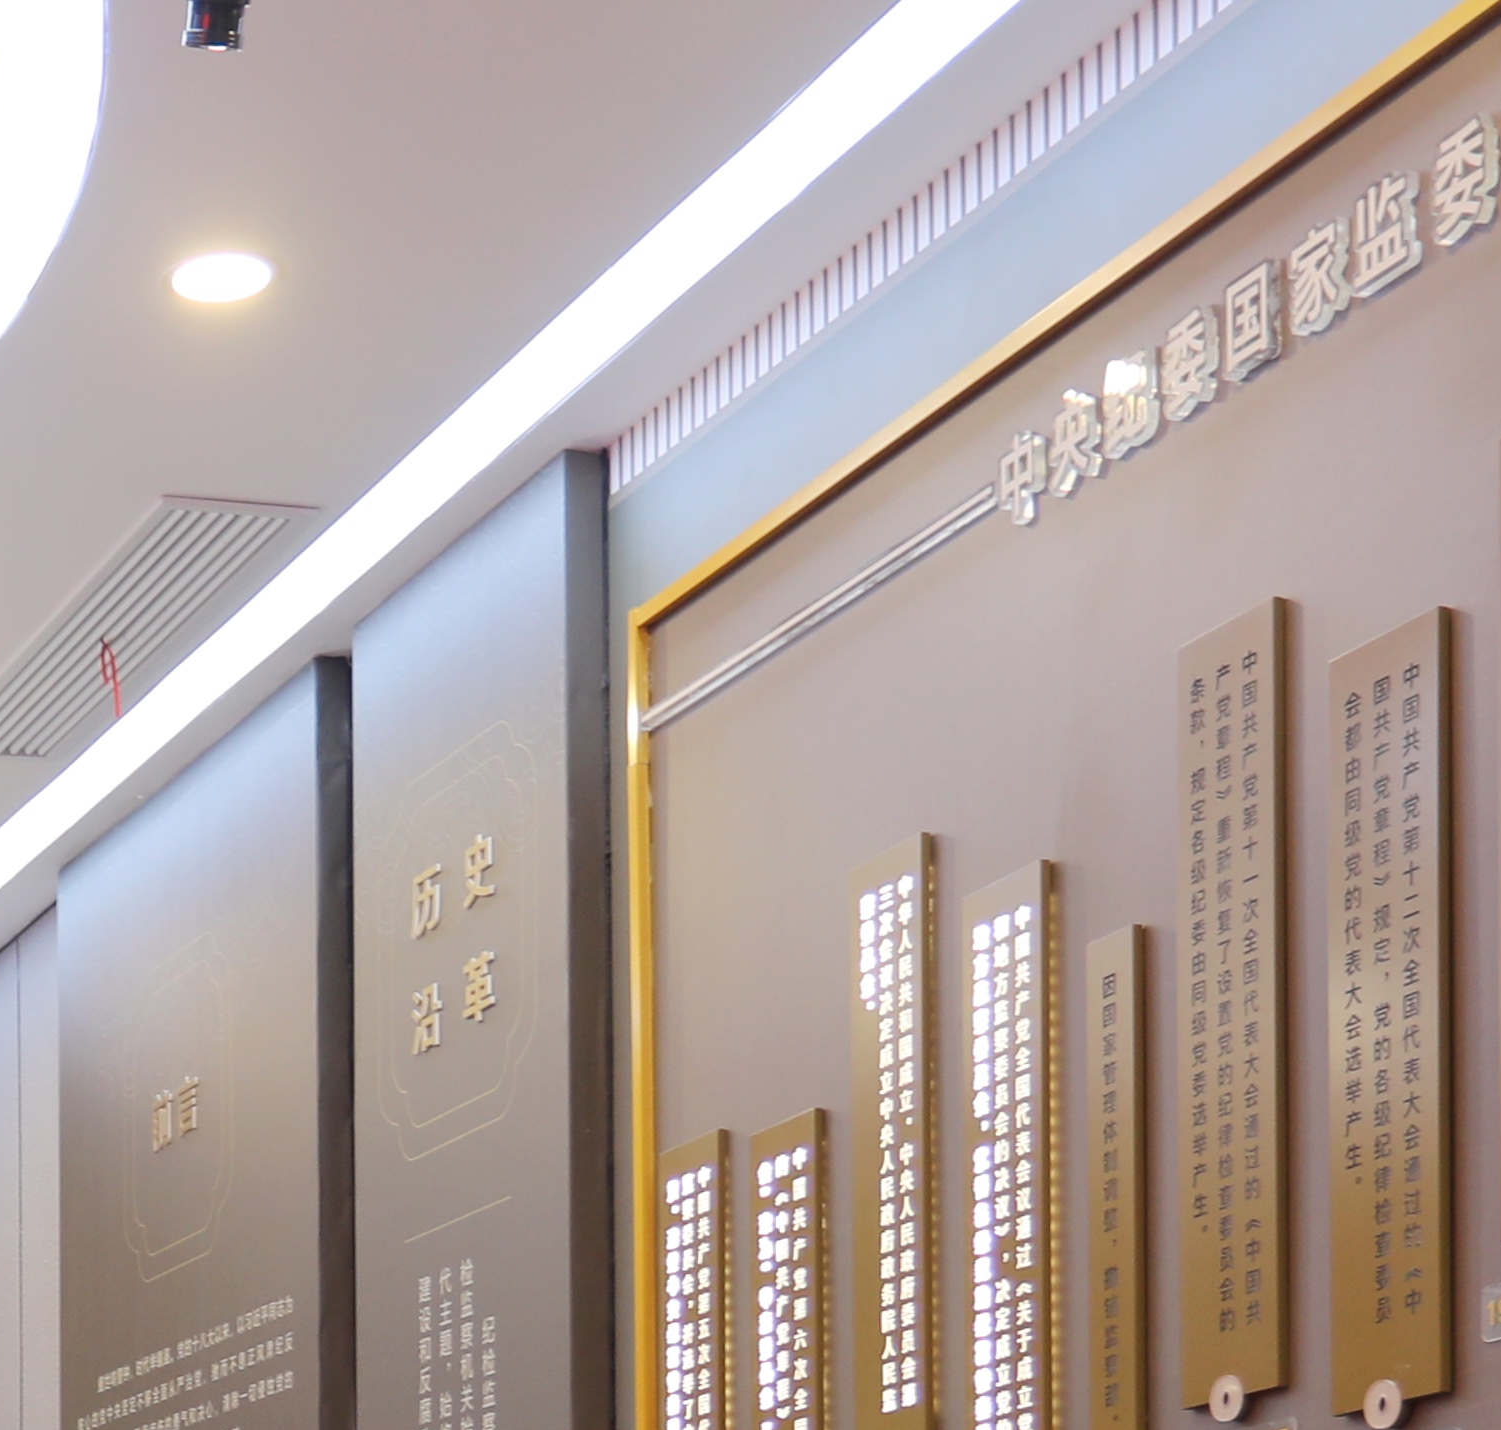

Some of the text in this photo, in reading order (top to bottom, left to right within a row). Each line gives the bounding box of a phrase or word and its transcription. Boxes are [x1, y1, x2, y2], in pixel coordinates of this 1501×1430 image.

[411, 833, 496, 939] 历史
[1344, 691, 1363, 1186] 会都由同级党的代表大会选举产生。
[411, 950, 497, 1056] 沿革
